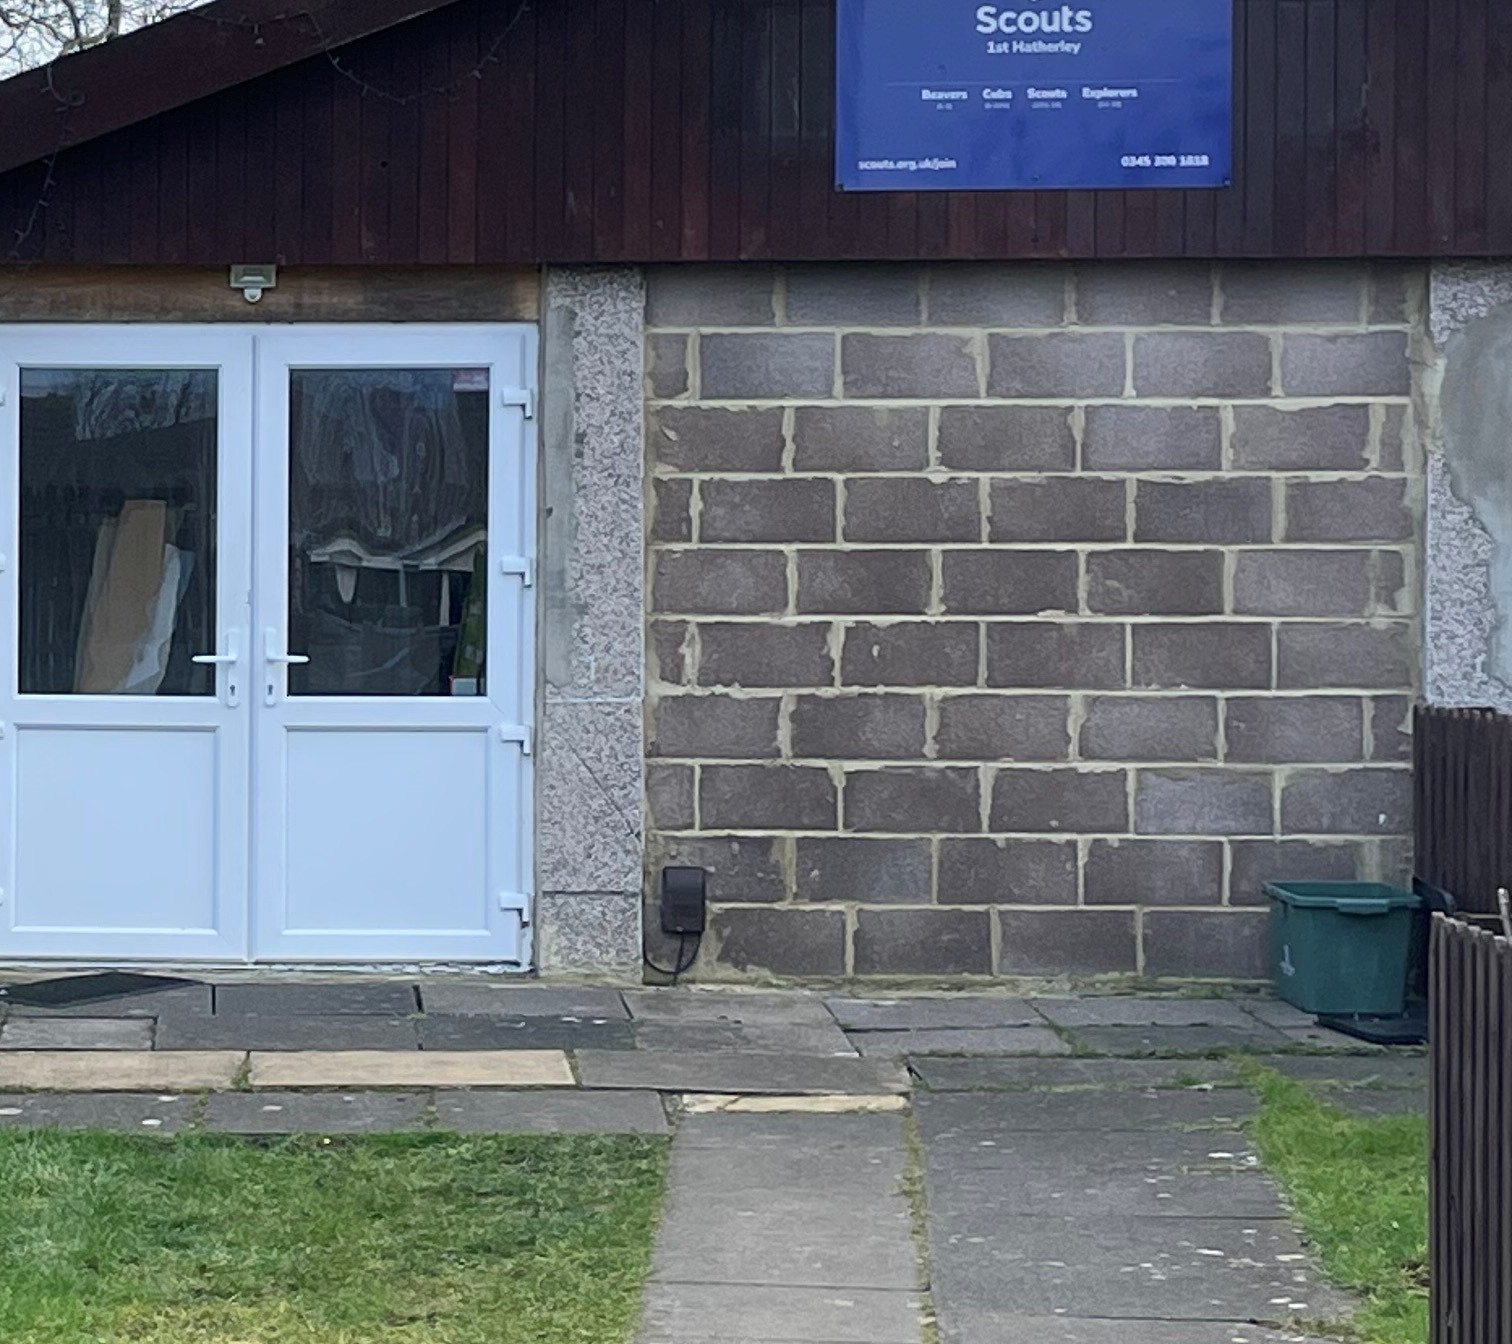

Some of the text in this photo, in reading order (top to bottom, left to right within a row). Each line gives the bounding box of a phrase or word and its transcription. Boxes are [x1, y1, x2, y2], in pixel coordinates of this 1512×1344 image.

[975, 5, 1093, 34] Scouts
[987, 40, 1081, 55] 1st Hatherley
